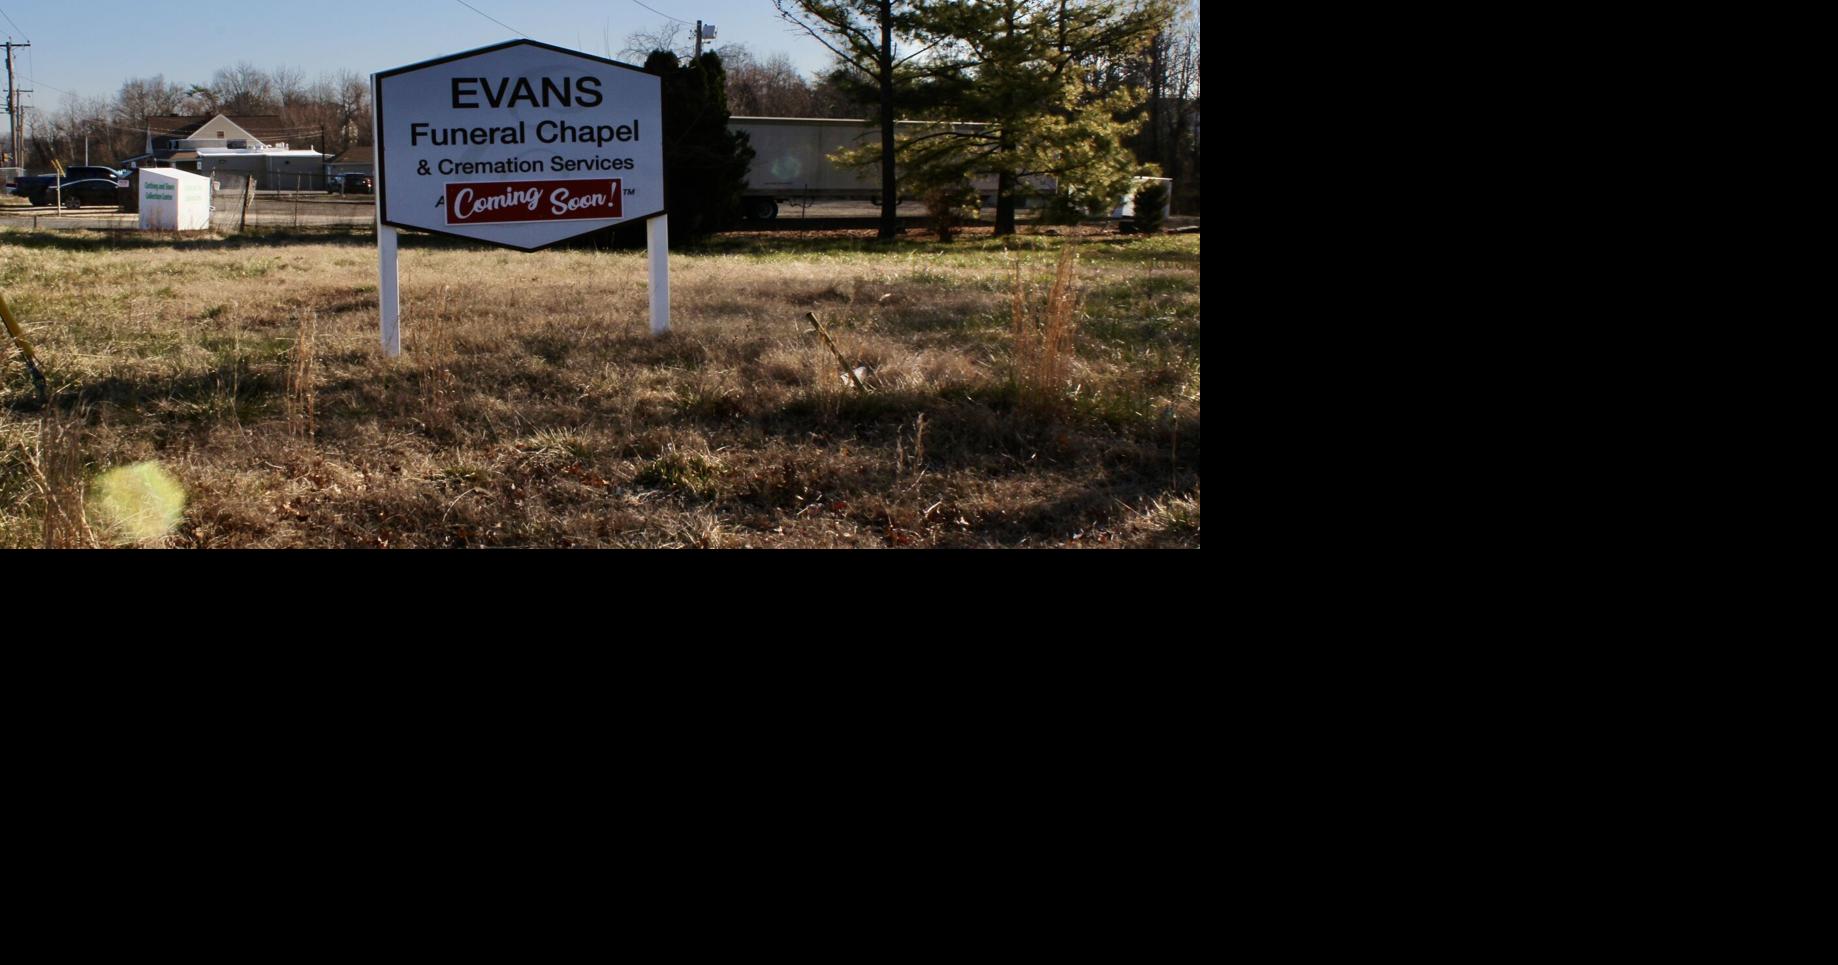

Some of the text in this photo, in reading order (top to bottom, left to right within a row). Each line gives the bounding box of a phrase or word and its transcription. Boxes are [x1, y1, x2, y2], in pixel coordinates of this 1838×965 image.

[451, 76, 603, 109] EVANS
[410, 119, 639, 147] Funeral Chapel
[416, 156, 635, 175] & Cremation Services
[454, 181, 617, 219] Coming Soon!
